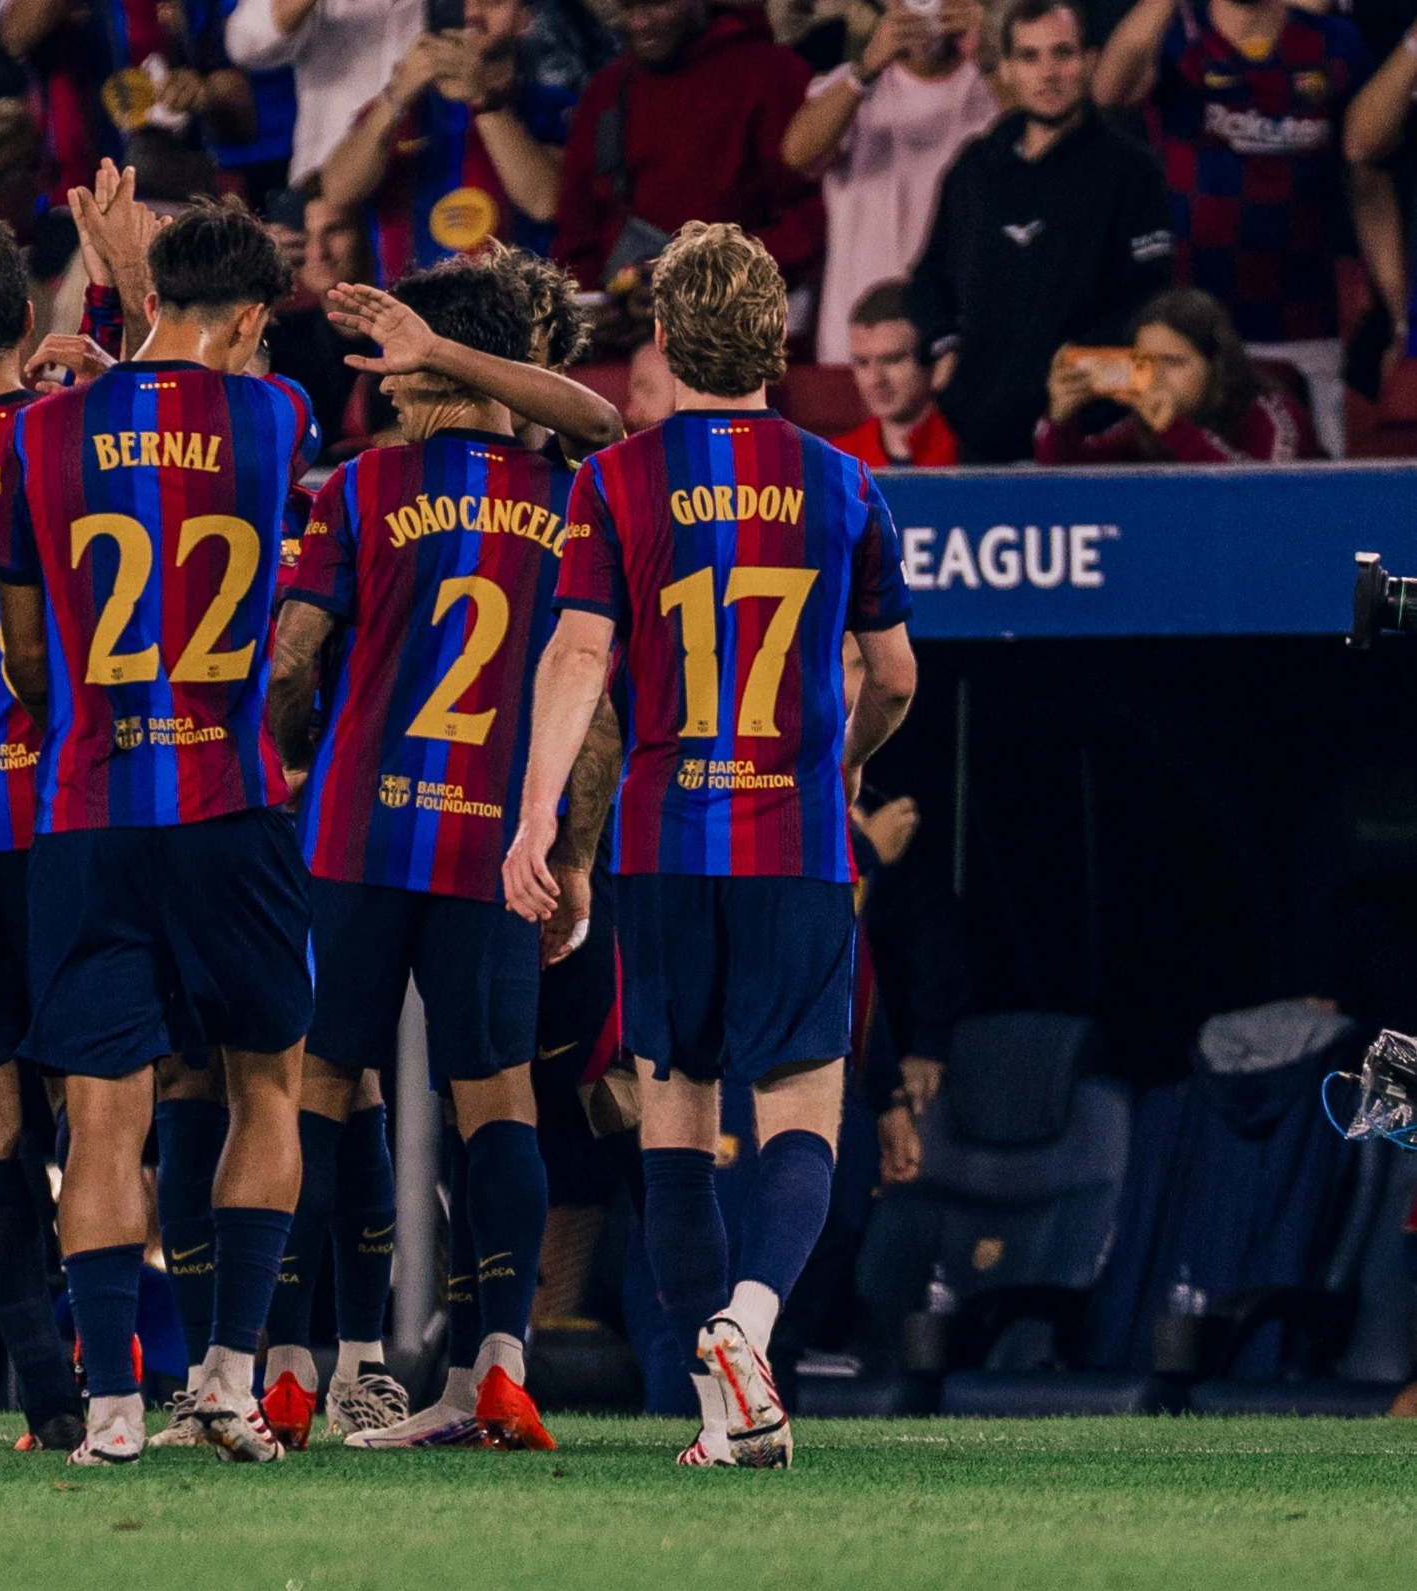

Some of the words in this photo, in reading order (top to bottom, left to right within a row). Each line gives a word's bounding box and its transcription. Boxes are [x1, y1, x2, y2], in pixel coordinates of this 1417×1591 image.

[92, 431, 222, 473] BERNAL
[384, 494, 456, 549] JOÃO
[670, 485, 805, 526] GORDON
[902, 524, 1105, 591] EAGUE
[70, 513, 261, 685] 22
[405, 575, 510, 746] 2
[660, 566, 821, 738] 17
[148, 717, 194, 732] BARÇA
[149, 726, 228, 746] FOUNDATIO
[708, 760, 755, 776] BARÇA
[708, 774, 795, 789] FOUNDATION
[415, 795, 503, 819] FOUNDATION
[417, 780, 464, 800] BARÇA
